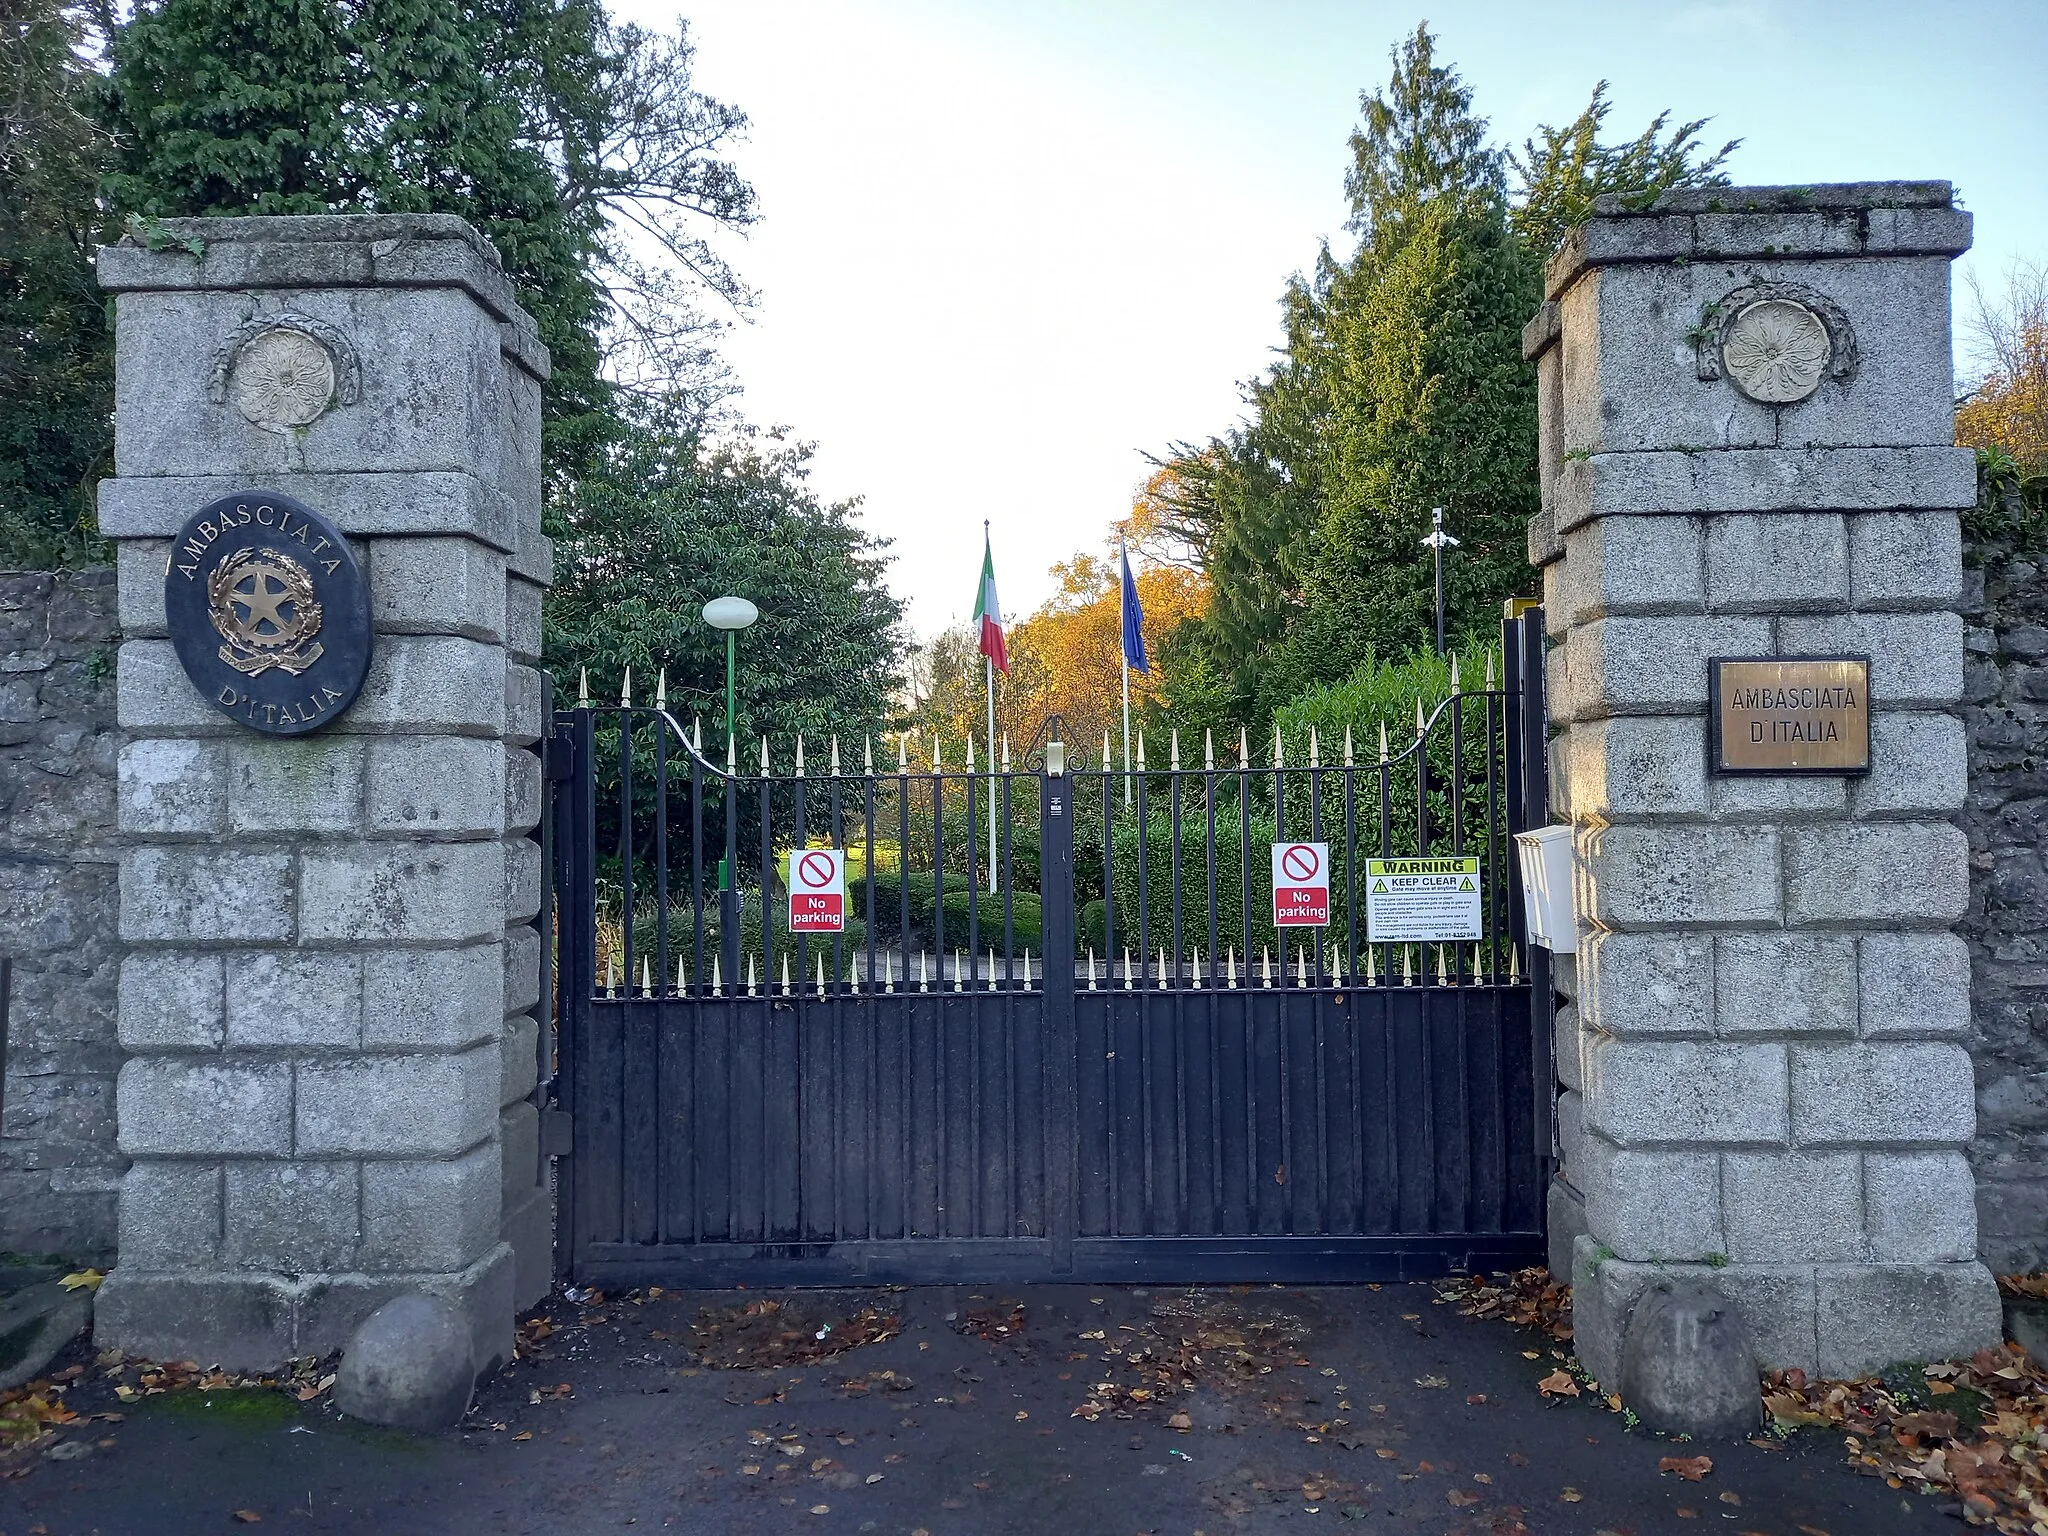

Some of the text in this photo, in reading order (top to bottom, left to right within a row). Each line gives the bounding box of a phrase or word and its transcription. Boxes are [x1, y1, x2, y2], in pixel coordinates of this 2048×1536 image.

[176, 504, 341, 581] AMBASCIATA
[217, 685, 344, 725] D'ITALIA
[1731, 687, 1857, 710] AMBASCIATA
[1750, 720, 1839, 743] D'ITALIA
[1383, 859, 1465, 874] WARNING
[1392, 877, 1457, 886] KEEP CLEAR
[808, 897, 826, 908] No
[1293, 891, 1311, 902] No
[793, 911, 841, 925] parking
[1278, 905, 1326, 919] parking
